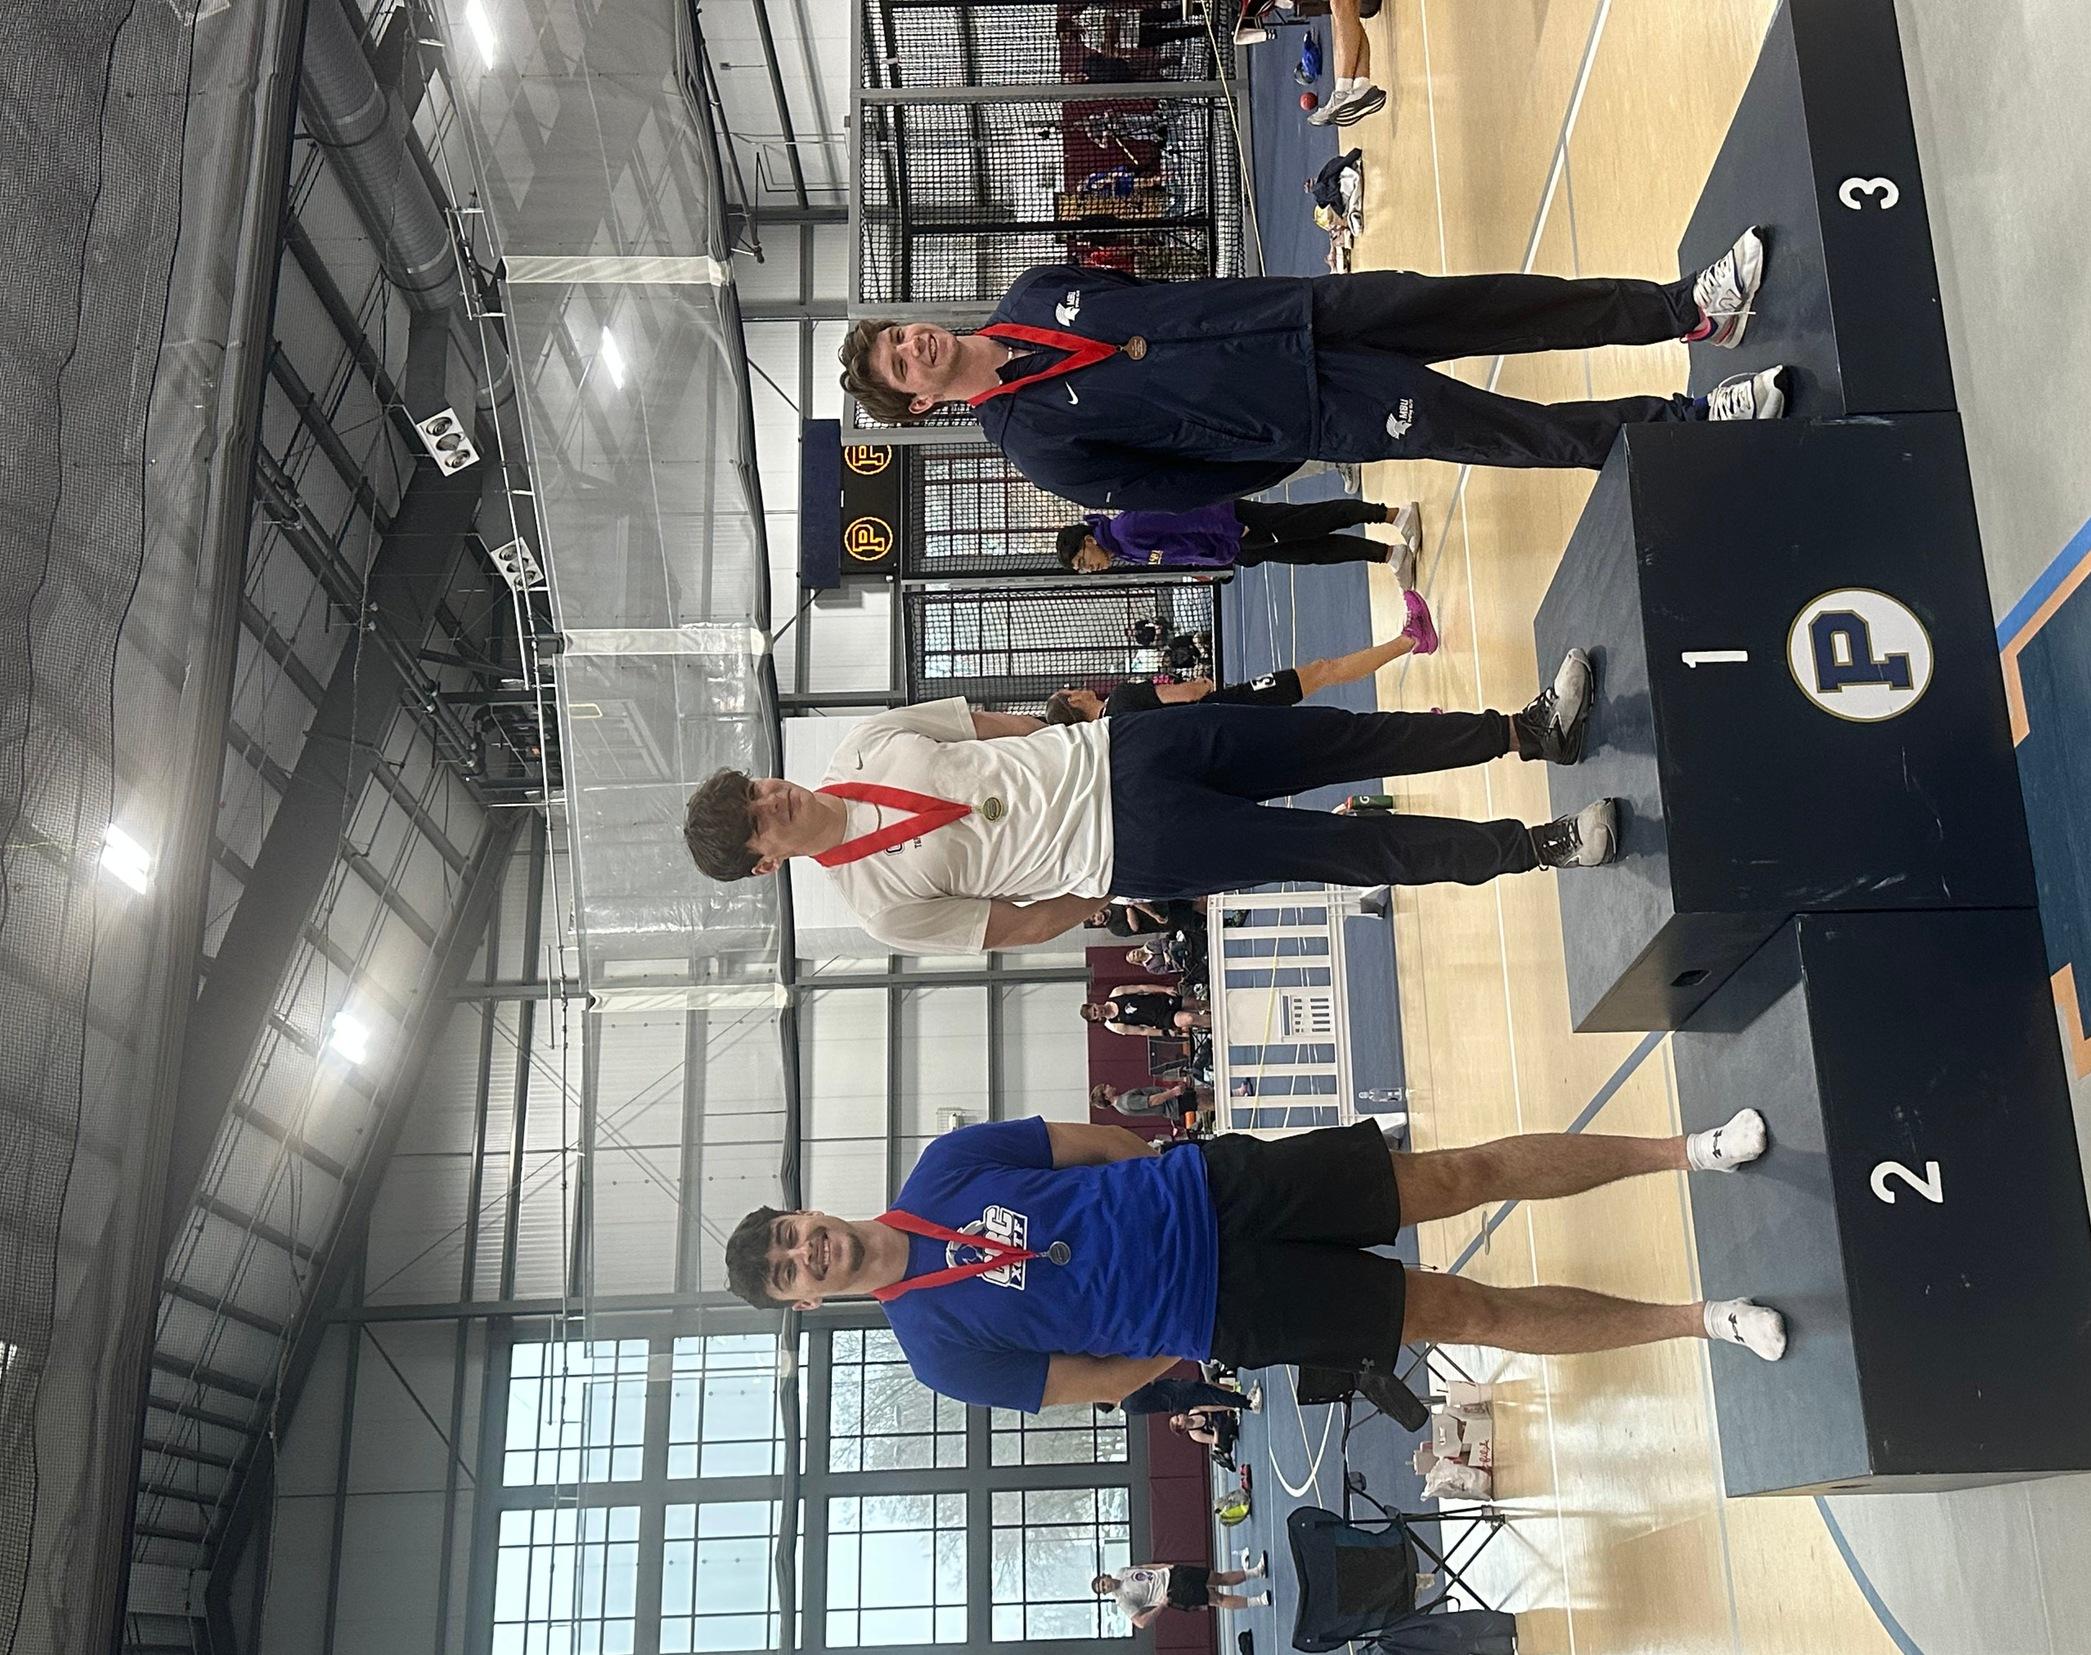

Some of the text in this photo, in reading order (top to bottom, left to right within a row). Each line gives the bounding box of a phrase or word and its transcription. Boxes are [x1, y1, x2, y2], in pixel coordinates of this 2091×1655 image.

[1838, 176, 1900, 210] 3
[1398, 398, 1409, 420] MBU
[852, 524, 885, 552] P
[1681, 650, 1749, 668] 1
[1807, 609, 1914, 693] P
[1870, 1160, 1944, 1204] 2
